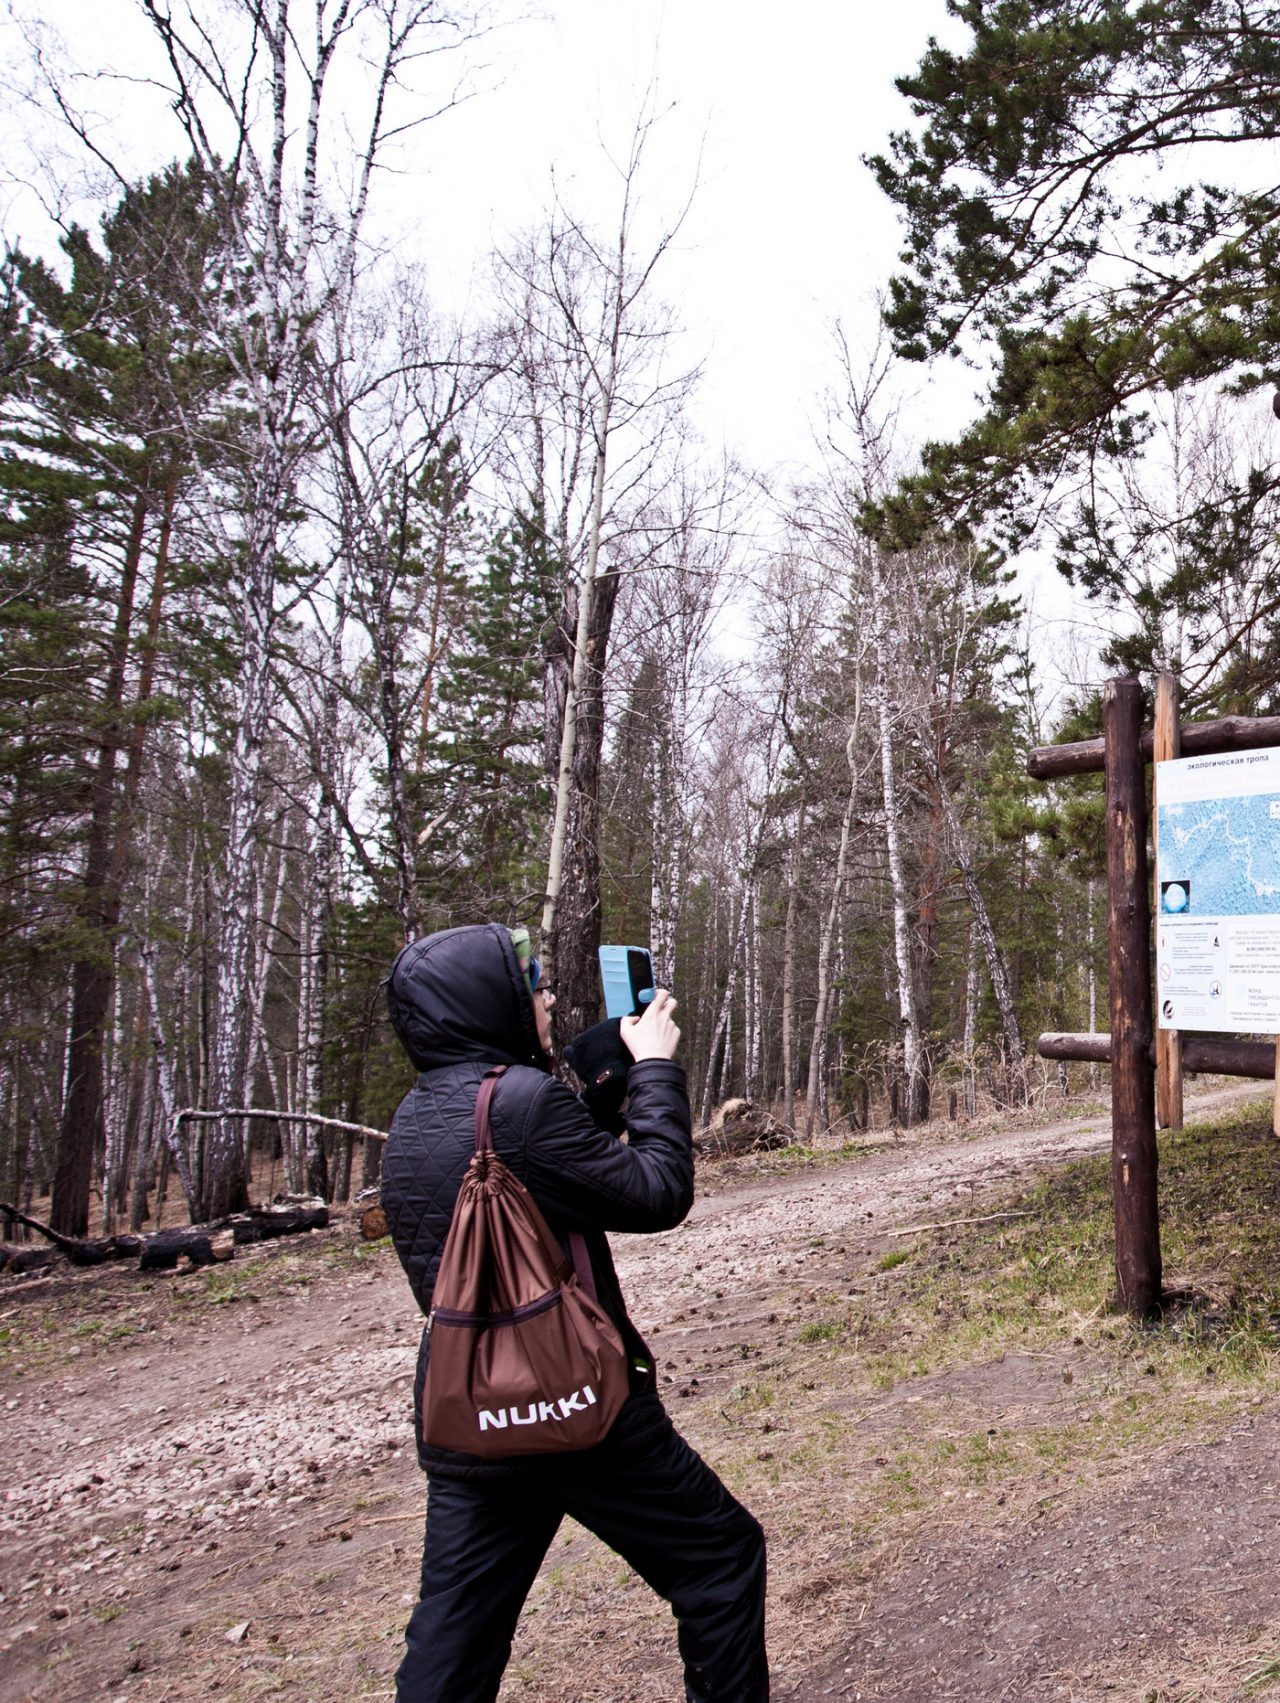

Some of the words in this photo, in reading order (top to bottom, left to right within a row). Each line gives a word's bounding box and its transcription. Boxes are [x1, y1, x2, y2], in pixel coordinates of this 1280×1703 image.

[1187, 758, 1244, 770] экологическая
[1247, 755, 1269, 765] тропа
[478, 1385, 597, 1431] NUKKI
